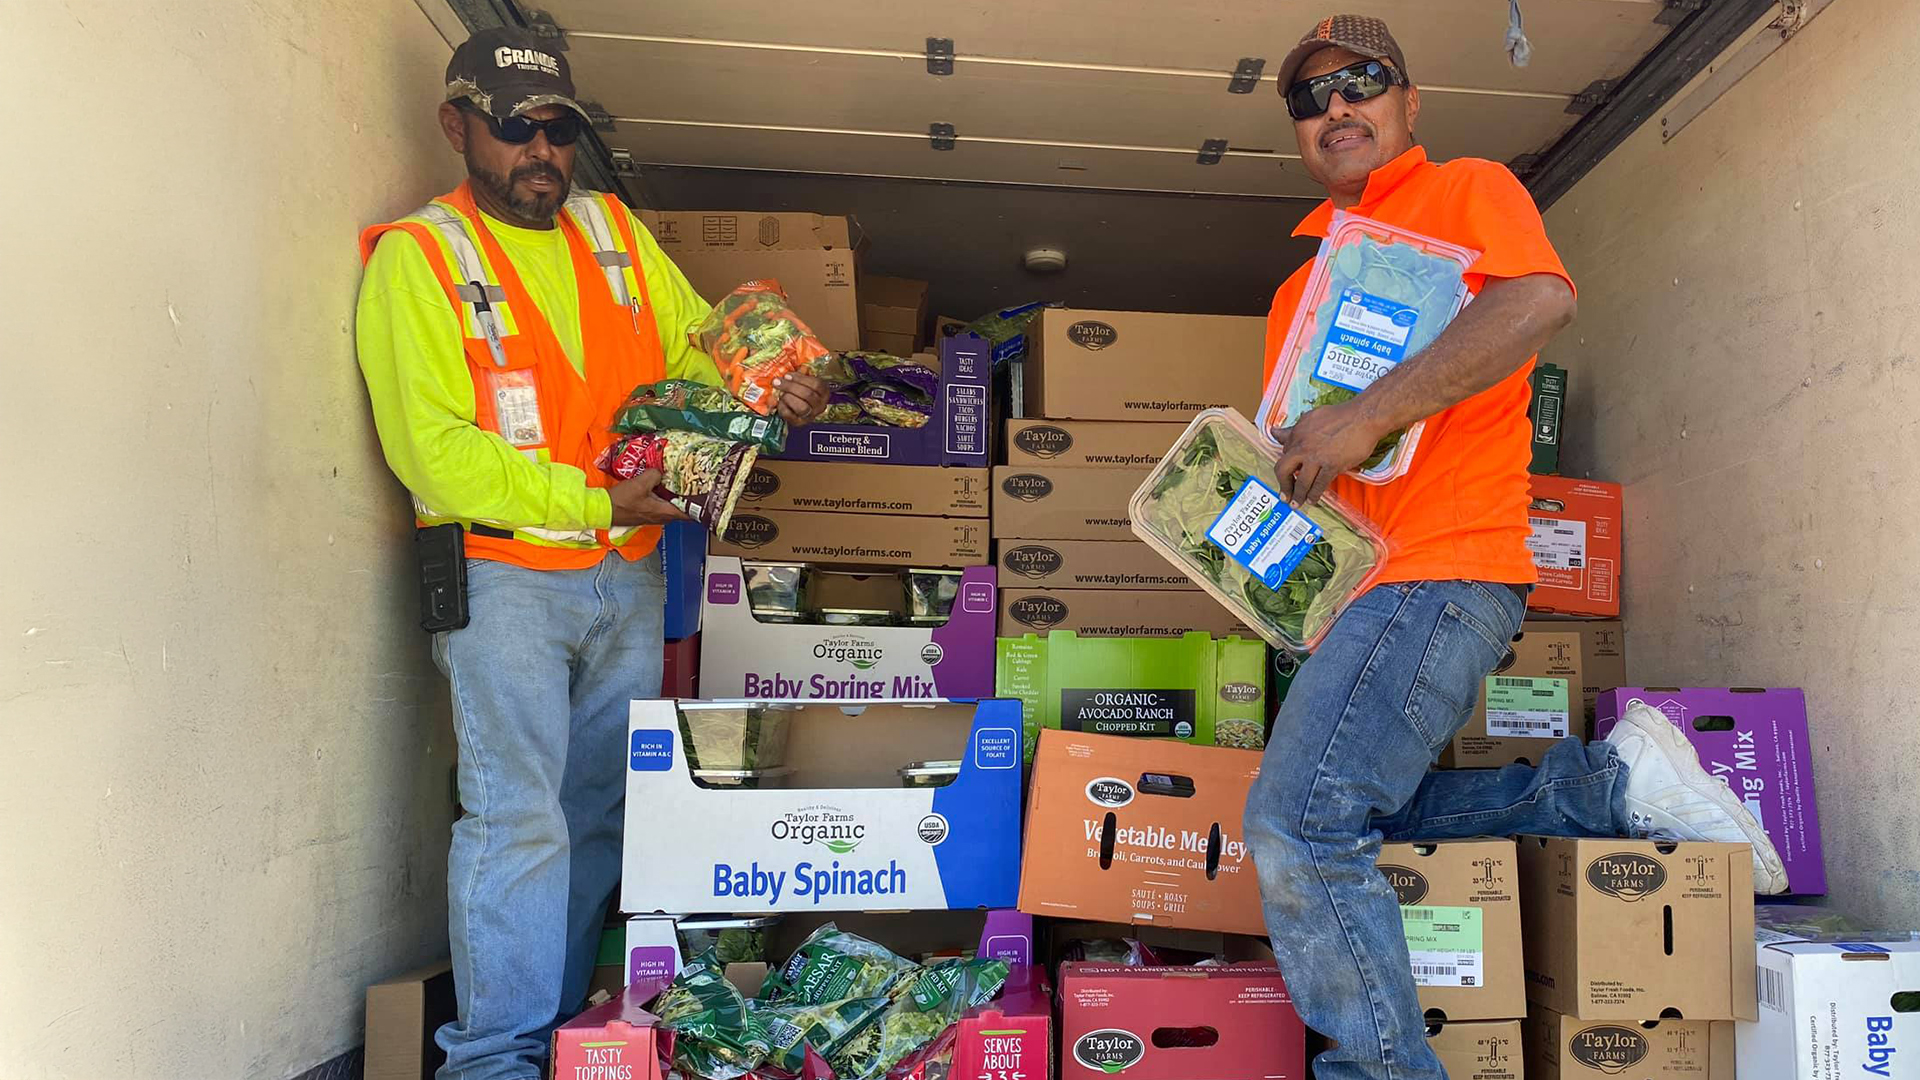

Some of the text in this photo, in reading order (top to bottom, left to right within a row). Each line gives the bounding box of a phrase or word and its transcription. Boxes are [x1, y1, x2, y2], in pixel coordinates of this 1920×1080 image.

[494, 46, 560, 71] GRANDE
[1075, 324, 1111, 336] Taylor
[1340, 333, 1392, 355] baby spinach
[958, 365, 973, 373] IDEAS
[958, 406, 974, 414] TACOS
[1124, 400, 1229, 411] www.taylorfarmscom
[829, 435, 871, 446] Iceberg &
[1023, 430, 1064, 442] Taylor
[817, 444, 882, 455] Romaine Blend
[1086, 454, 1163, 464] www.taylorfar
[747, 473, 772, 485] ylor
[1010, 478, 1046, 489] Taylor
[793, 497, 913, 511] www.taylorfarms.com
[1223, 495, 1258, 534] Taylor Farms
[1223, 493, 1272, 549] Organic
[729, 521, 770, 533] Taylor
[1244, 510, 1283, 556] baby spinach
[792, 545, 912, 559] www.taylorfarms.com
[1013, 551, 1054, 563] Taylor
[1075, 574, 1189, 585] www.taylorfarms.com
[1019, 602, 1061, 614] Taylor
[1080, 625, 1193, 636] www.taylorfarms.com
[823, 639, 875, 648] Taylor Farms
[813, 644, 883, 662] Organic
[744, 673, 934, 699] Baby Spring Mix
[1225, 684, 1257, 695] Taylor
[1095, 693, 1158, 705] ORGANIC
[1078, 707, 1173, 719] AVOCADO RANCH
[1095, 722, 1155, 732] CHOPPED KIT
[1733, 730, 1757, 771] Mix
[1097, 783, 1127, 795] Taylor
[785, 813, 854, 824] Taylor Farms
[771, 820, 865, 845] Organic
[1083, 819, 1248, 863] Veetable Meley
[1087, 848, 1241, 874] Broli, Carrots, and Caulower
[1598, 861, 1656, 878] Taylor
[713, 860, 907, 905] Baby Spinach
[1388, 872, 1416, 887] lor
[1611, 879, 1644, 888] FARMS
[1132, 889, 1188, 903] SAUTÉ ROAST
[1132, 900, 1186, 913] SOUPS GRILL
[1830, 1002, 1838, 1038] Distributed
[1810, 1015, 1818, 1044] Certified
[984, 1038, 1022, 1054] SERVES
[1087, 1037, 1134, 1055] Taylor
[1581, 1034, 1637, 1049] Taylor
[1862, 1016, 1896, 1077] Baby
[585, 1049, 623, 1064] TASTY
[983, 1054, 1022, 1070] ABOUT
[1096, 1052, 1124, 1060] FARMS
[1593, 1051, 1626, 1061] FARMS
[575, 1065, 632, 1080] TOPPINGS
